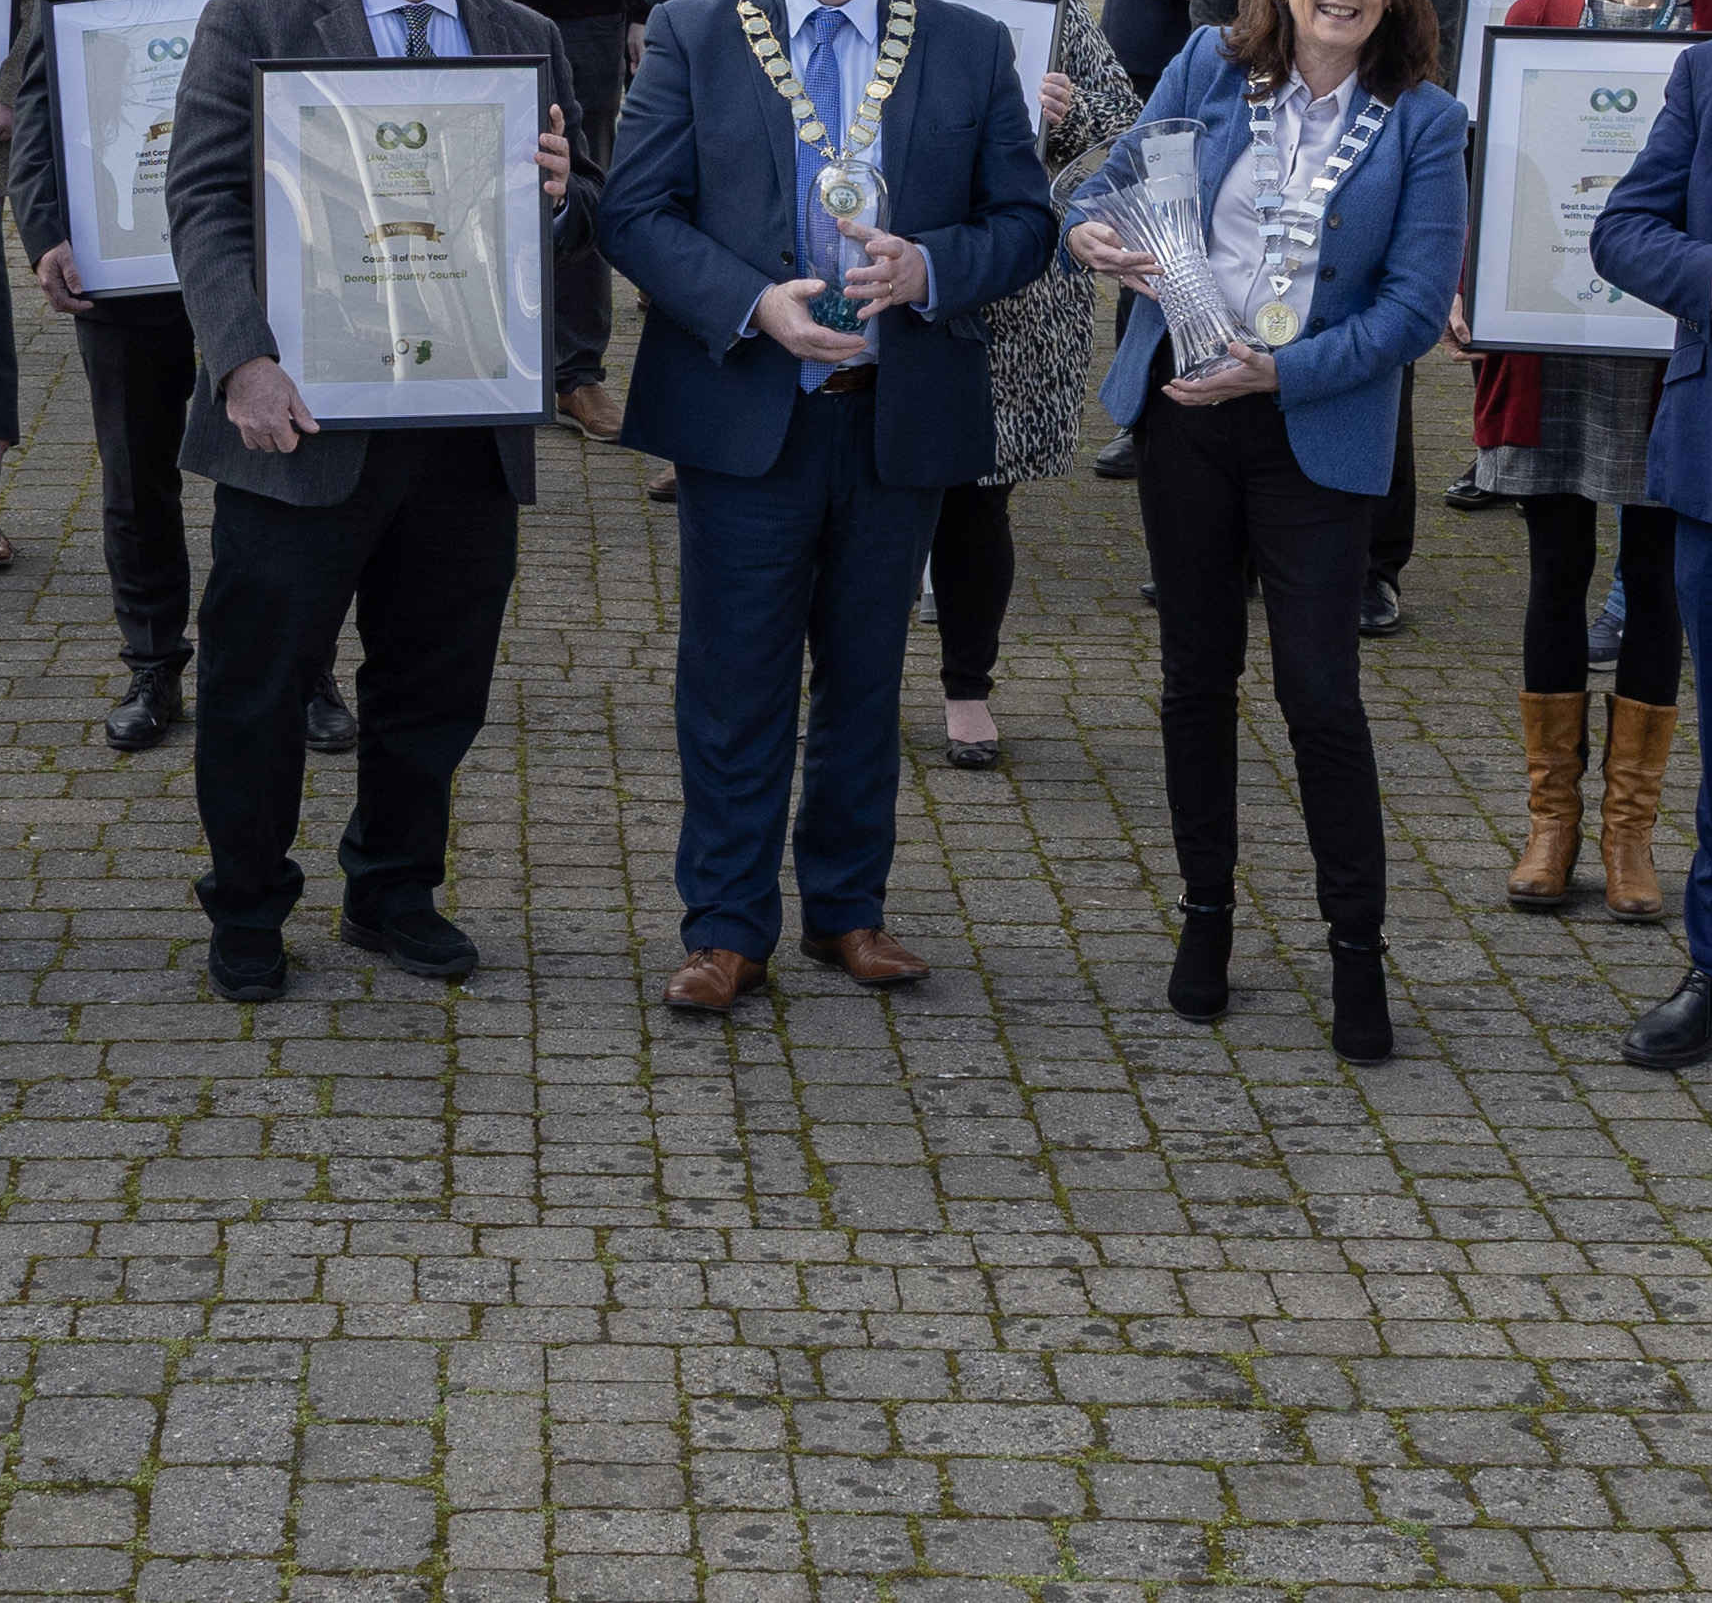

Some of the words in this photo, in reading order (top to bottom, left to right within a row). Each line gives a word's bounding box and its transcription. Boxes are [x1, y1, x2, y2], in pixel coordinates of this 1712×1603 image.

[139, 172, 159, 180] Love
[388, 170, 425, 179] COUNCIL
[1552, 245, 1588, 255] Donegal
[362, 254, 397, 263] Council
[399, 254, 408, 262] of
[427, 253, 448, 261] Year
[344, 273, 387, 284] Donegal
[389, 271, 426, 282] County
[429, 269, 467, 279] Council
